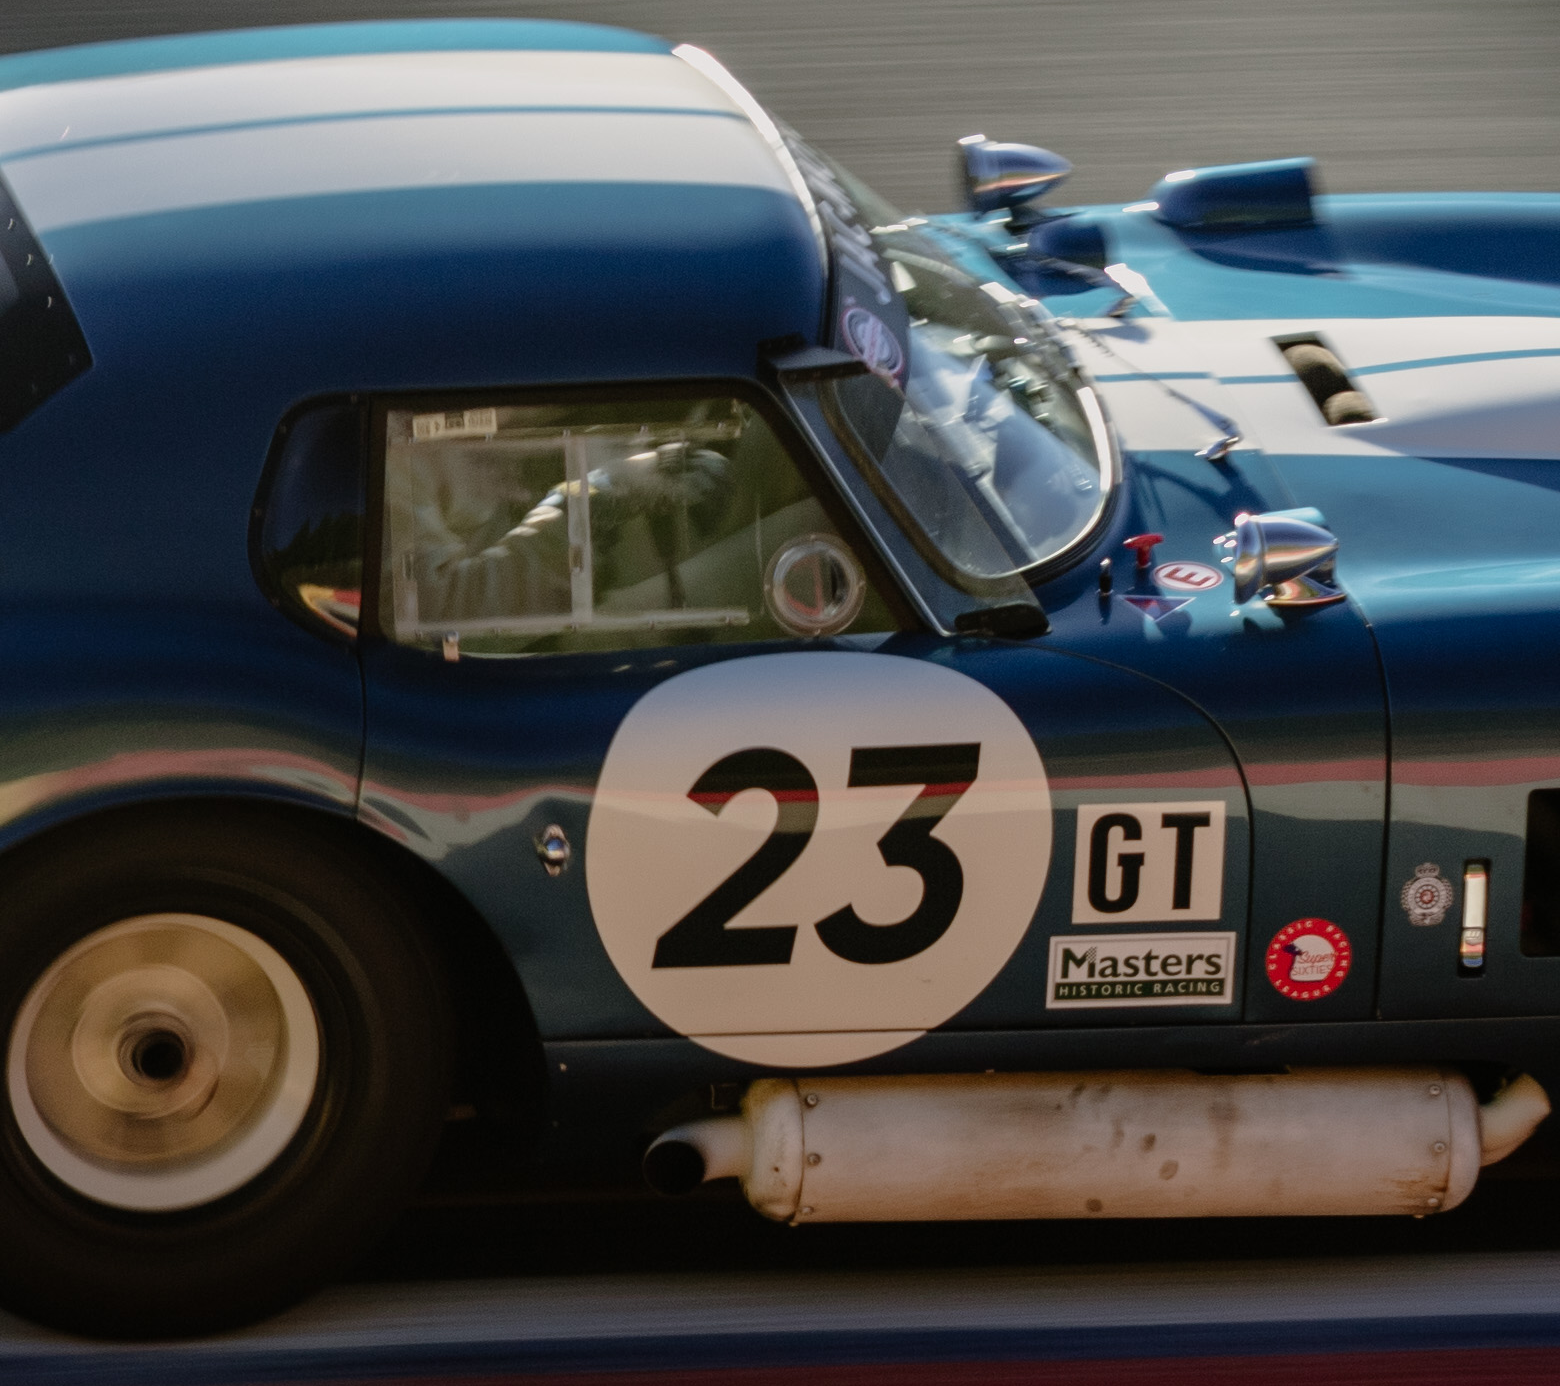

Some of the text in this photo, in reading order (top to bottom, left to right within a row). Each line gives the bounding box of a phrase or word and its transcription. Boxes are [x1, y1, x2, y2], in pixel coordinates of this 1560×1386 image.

[651, 742, 981, 969] 23
[1087, 811, 1211, 914] GT
[1060, 946, 1222, 979] Masters
[1268, 920, 1349, 978] CLASSIC RACING
[1292, 965, 1333, 977] SIXTIES
[1058, 980, 1222, 998] HISTORIC RACING
[1273, 979, 1332, 1000] LEAGUE
